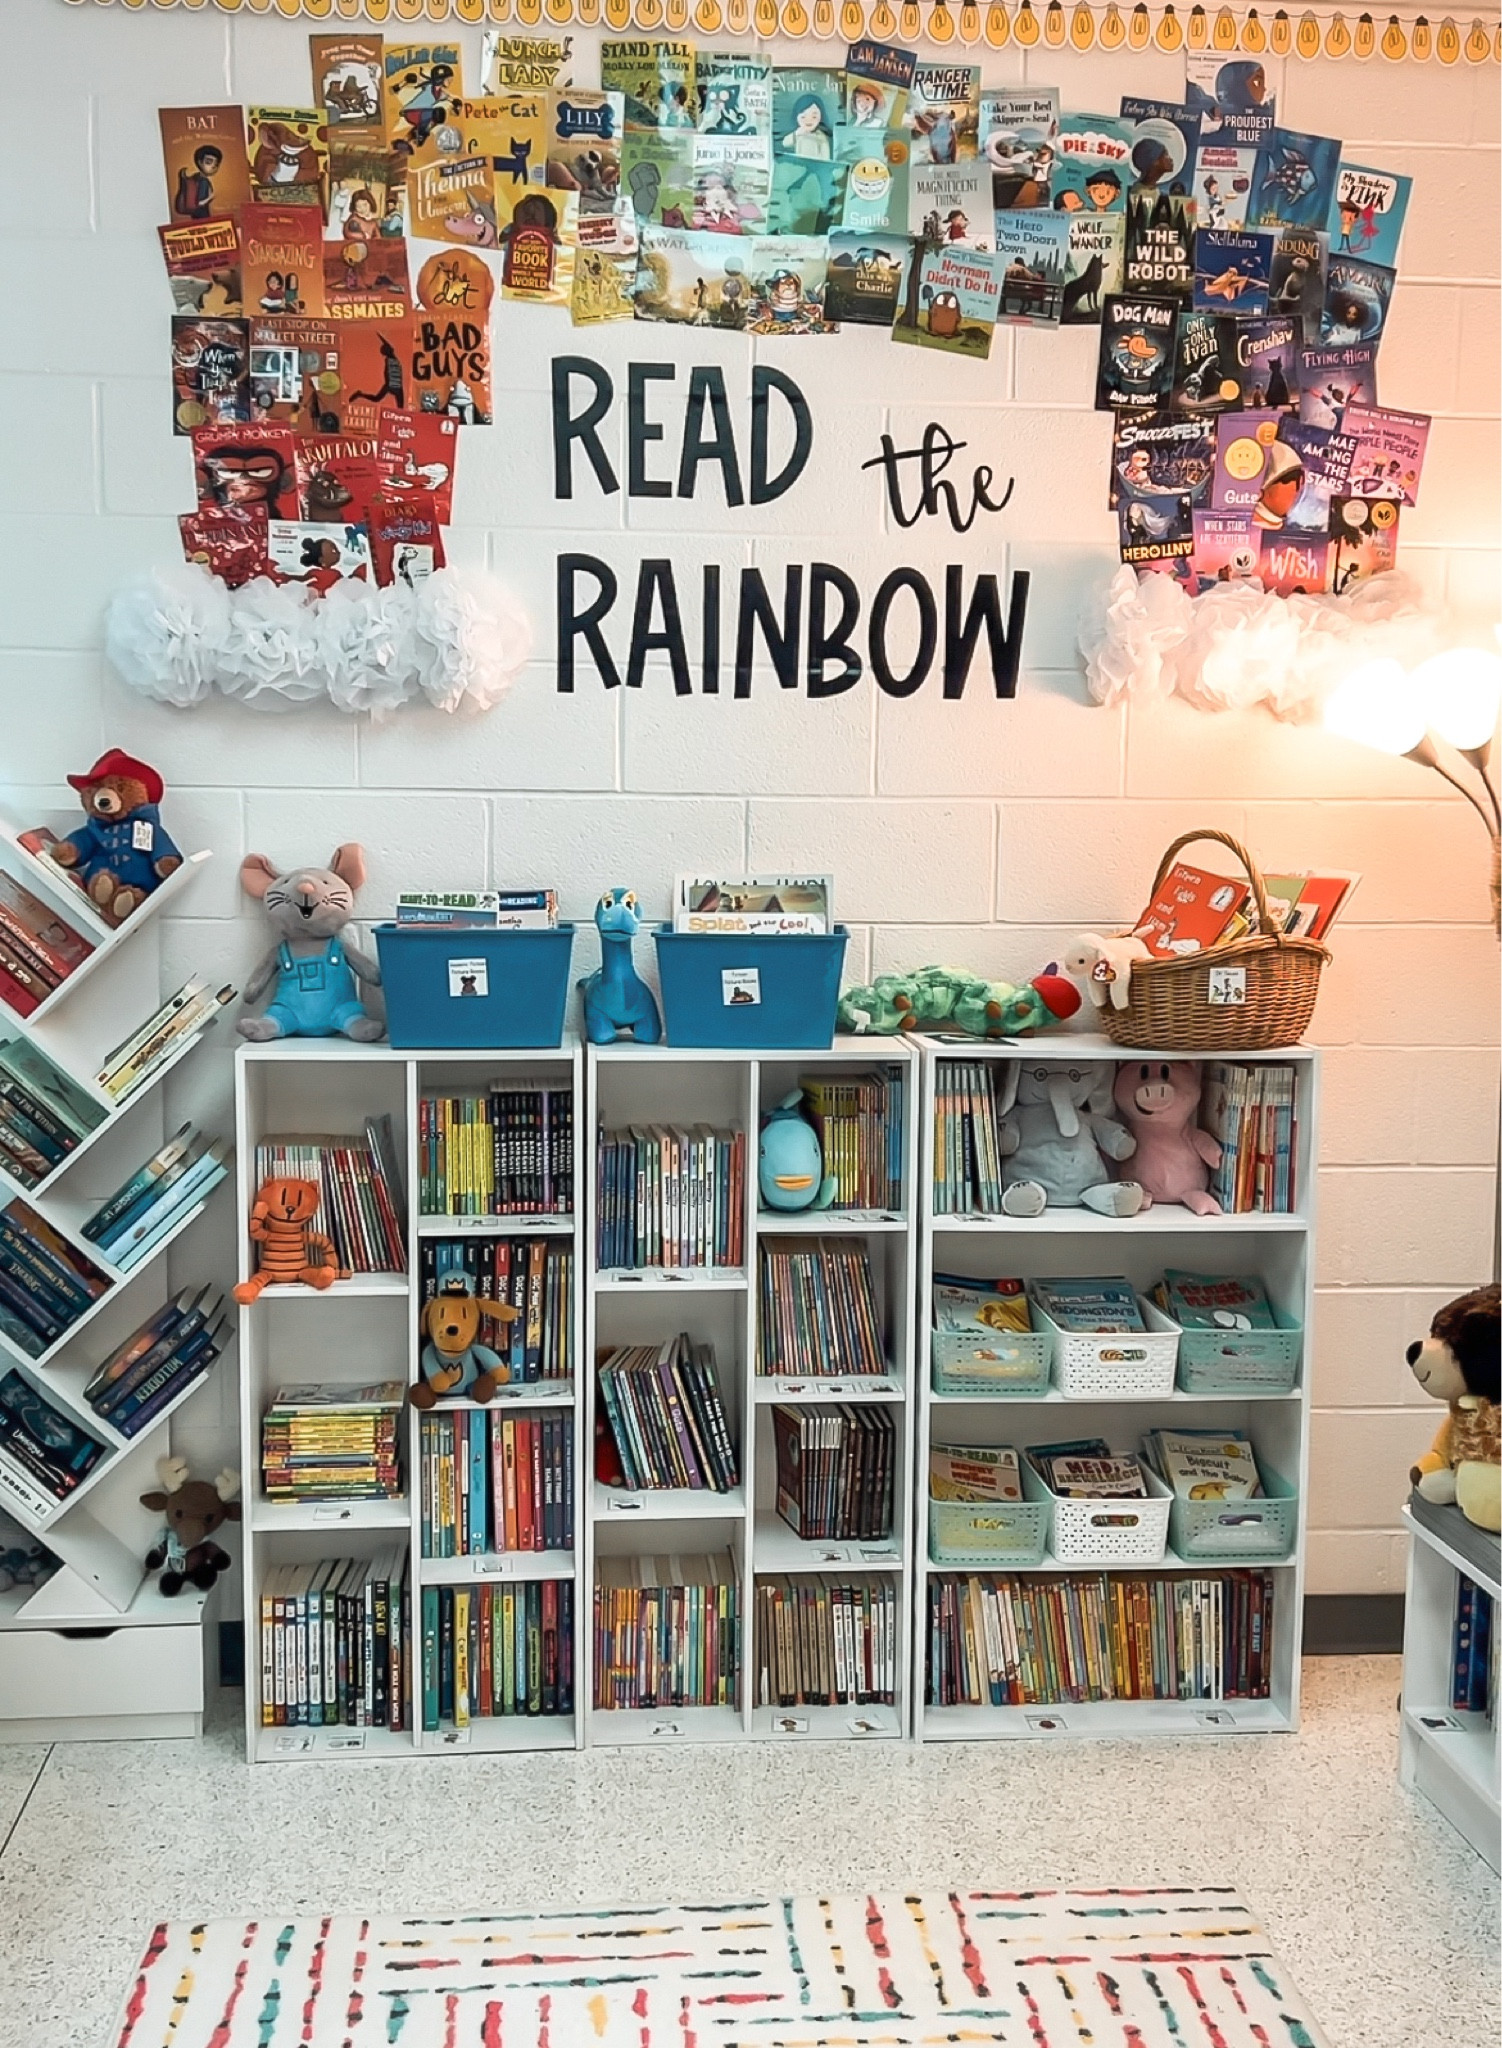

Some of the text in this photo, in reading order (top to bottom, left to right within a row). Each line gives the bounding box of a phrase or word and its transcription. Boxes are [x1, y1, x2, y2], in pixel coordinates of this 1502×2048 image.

[500, 37, 562, 58] LUNCH
[602, 42, 649, 58] STAND
[850, 46, 873, 64] CAM
[602, 61, 633, 71] MOLLY
[637, 62, 655, 70] LOU
[875, 55, 912, 79] JANSEN
[500, 64, 560, 86] LADY
[776, 74, 819, 93] Name
[914, 68, 972, 89] RANGER
[932, 83, 970, 100] TIME
[464, 103, 498, 119] Pete
[510, 102, 539, 118] Cat
[1009, 101, 1032, 113] Your
[186, 115, 218, 129] BAT
[566, 109, 605, 126] LILY
[1224, 115, 1273, 129] PROUDEST
[1236, 129, 1261, 141] BLUE
[734, 146, 766, 161] jones
[1096, 141, 1127, 160] SKY
[409, 159, 487, 200] Thelma
[935, 194, 962, 206] THING
[850, 211, 890, 227] Smile
[1015, 219, 1043, 232] Hero
[996, 229, 1057, 246] Two Doors
[1069, 235, 1113, 250] WANDER
[1145, 230, 1179, 244] THE
[248, 238, 316, 268] STARGAZING
[996, 241, 1027, 255] Down
[1136, 245, 1187, 263] WILD
[1276, 239, 1320, 260] NDLING
[513, 252, 549, 267] BOOK
[941, 259, 991, 281] Norman
[1128, 262, 1191, 282] ROBOT
[512, 276, 548, 289] WORLD
[856, 280, 894, 294] Charlie
[964, 277, 981, 292] Do
[433, 281, 480, 310] dot
[322, 302, 405, 319] ASSMATES
[1112, 304, 1173, 326] DOG MAN
[311, 320, 328, 330] ON
[298, 331, 337, 345] STREET
[421, 321, 482, 352] BAD
[1236, 328, 1294, 368] Crenshaw
[412, 348, 485, 381] GUYS
[1302, 349, 1370, 368] FLYING HIGH
[550, 355, 813, 507] READ
[1327, 434, 1357, 451] MAE
[1383, 439, 1419, 460] PEOPLE
[861, 421, 1015, 533] the
[1323, 462, 1350, 478] THE
[1306, 472, 1345, 492] STARS
[1224, 489, 1260, 504] Guts
[1123, 546, 1162, 561] HERO
[1269, 547, 1319, 580] Wish
[556, 552, 1030, 700] RAINBOW
[688, 917, 748, 931] Splat
[1185, 1455, 1231, 1469] Biscuit
[375, 1601, 386, 1619] NEW
